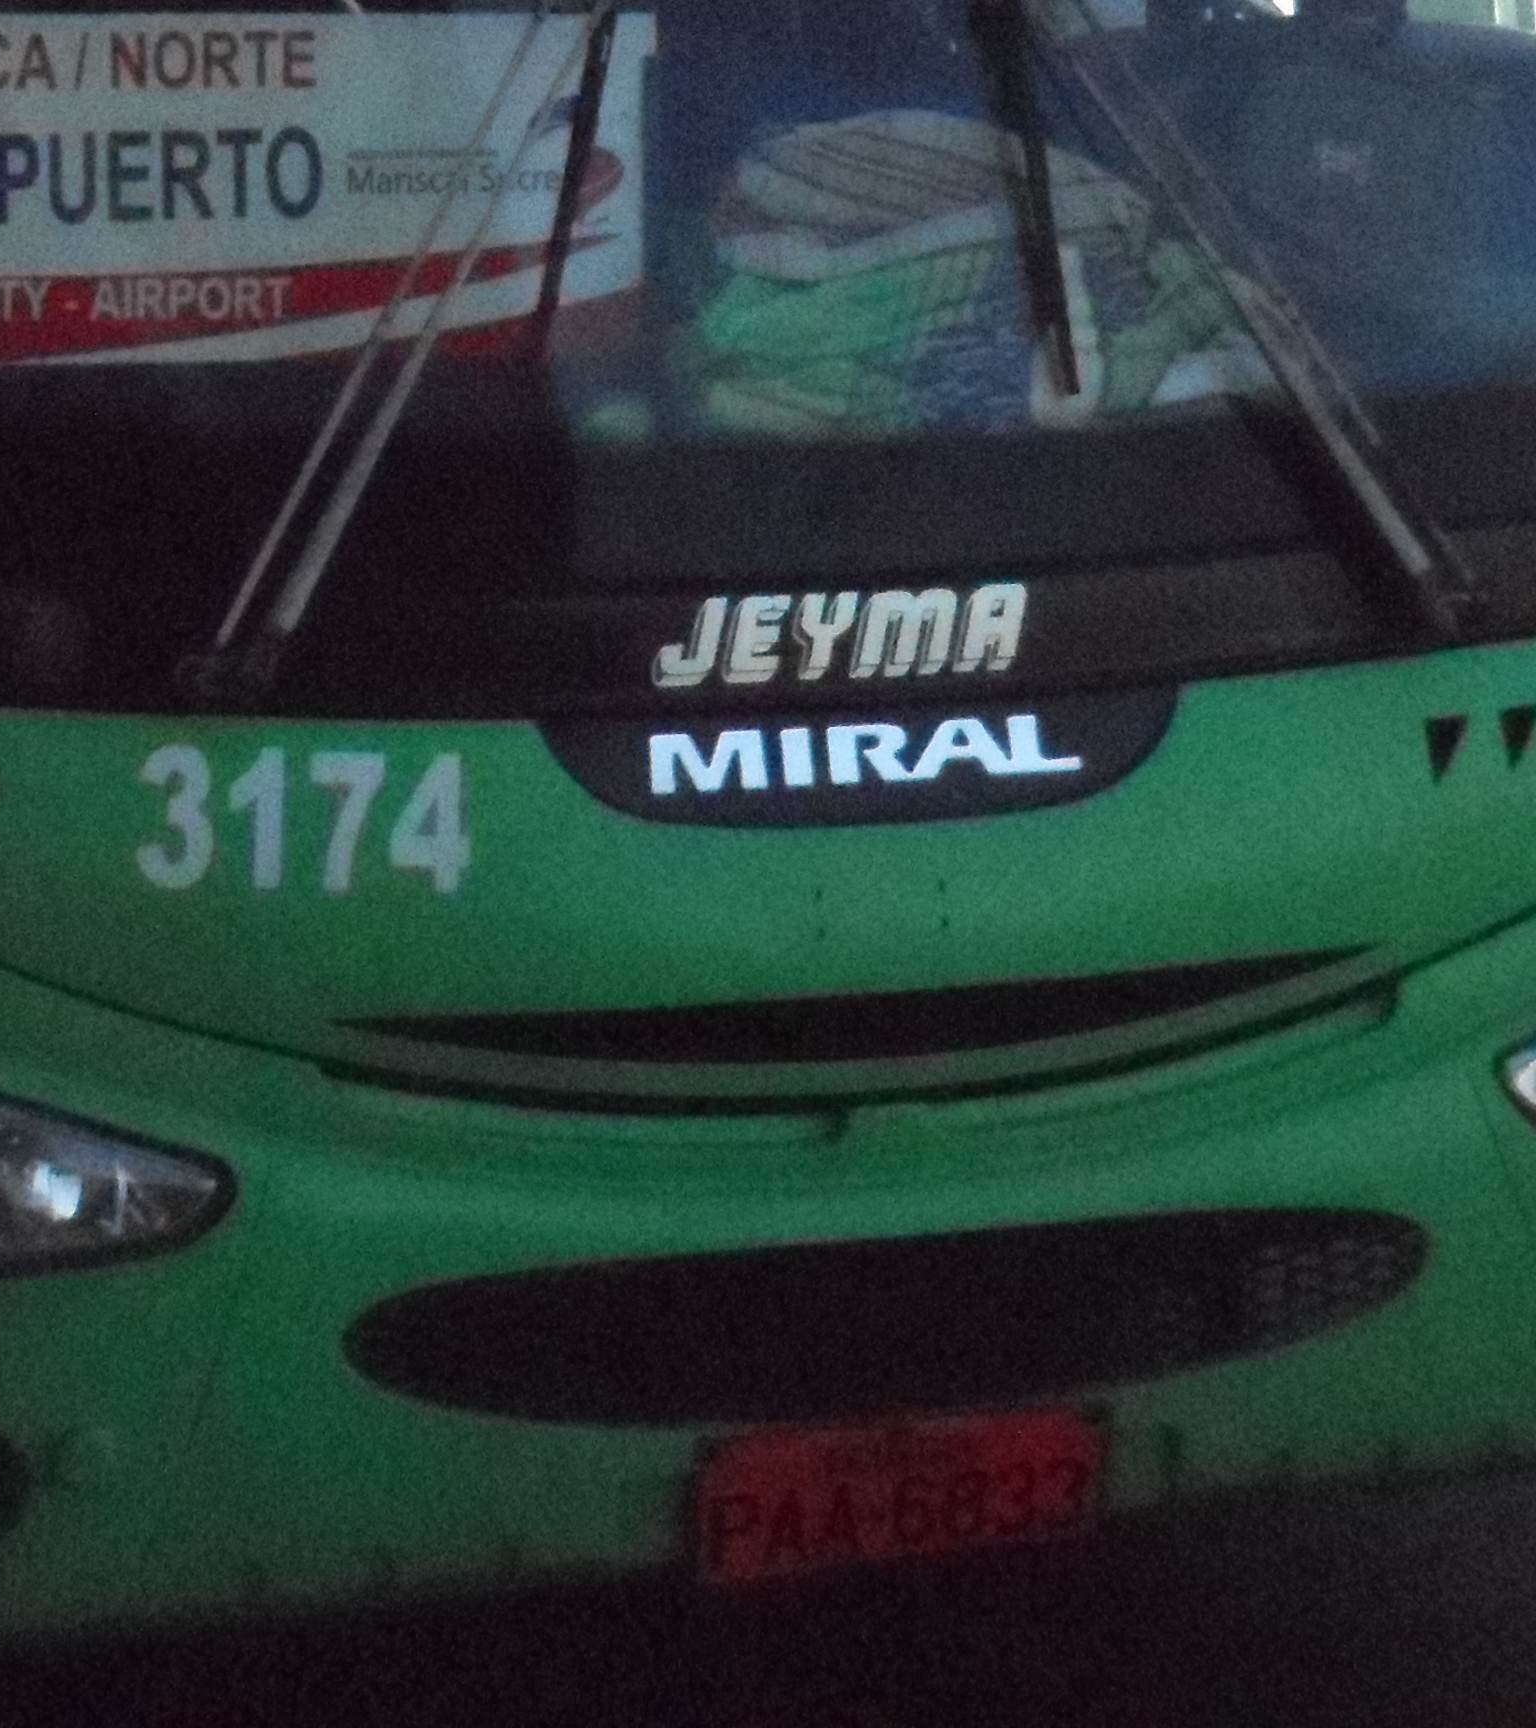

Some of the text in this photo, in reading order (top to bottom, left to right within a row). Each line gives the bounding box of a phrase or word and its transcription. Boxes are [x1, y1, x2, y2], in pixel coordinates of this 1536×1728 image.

[110, 28, 318, 91] NORTE
[90, 276, 295, 323] AIRPORT
[651, 582, 1029, 688] JEYMA
[648, 714, 1084, 795] MIRAL
[134, 742, 472, 896] 3174
